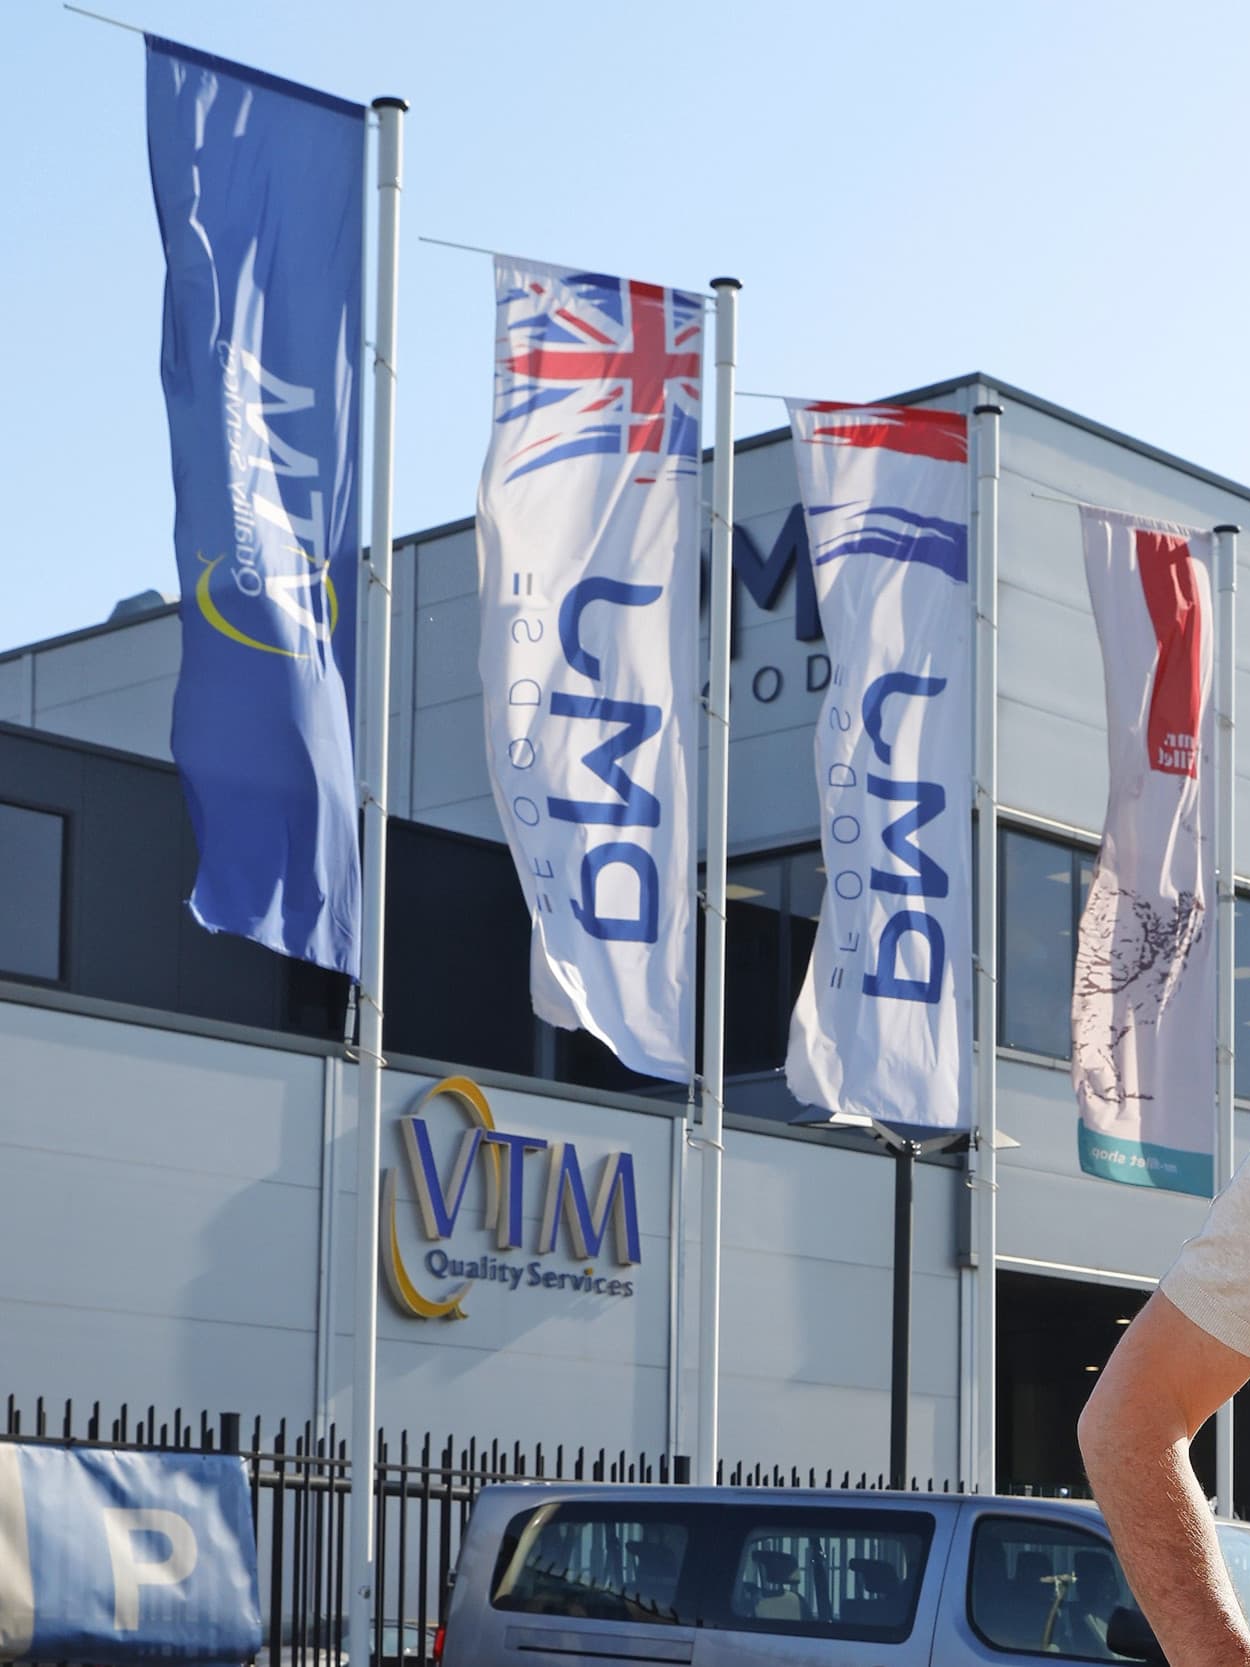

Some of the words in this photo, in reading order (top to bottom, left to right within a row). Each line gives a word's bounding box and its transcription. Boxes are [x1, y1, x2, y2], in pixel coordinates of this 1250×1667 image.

[401, 1115, 641, 1266] VTM
[424, 1249, 523, 1290] Quality
[526, 1262, 634, 1297] Services
[103, 1507, 198, 1631] P
